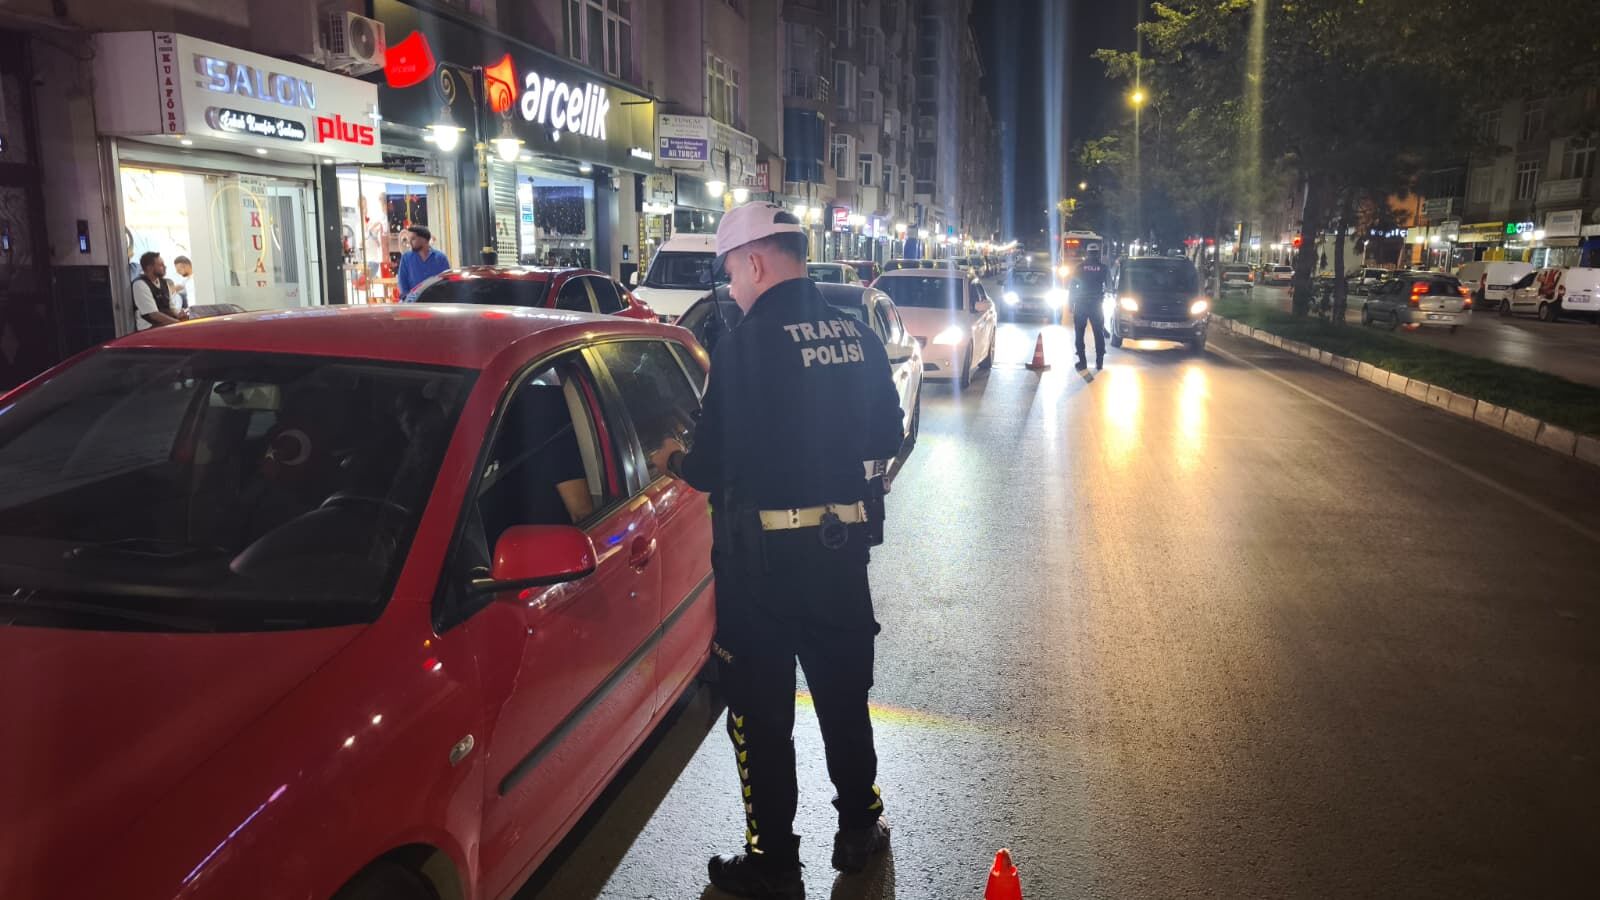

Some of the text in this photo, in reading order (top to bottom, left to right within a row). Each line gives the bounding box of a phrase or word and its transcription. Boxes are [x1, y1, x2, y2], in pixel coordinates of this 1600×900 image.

[202, 55, 317, 110] SALON
[520, 71, 610, 143] arçelik
[317, 114, 374, 146] plus
[783, 317, 862, 342] TRAFİK
[801, 339, 865, 368] POLİSİ
